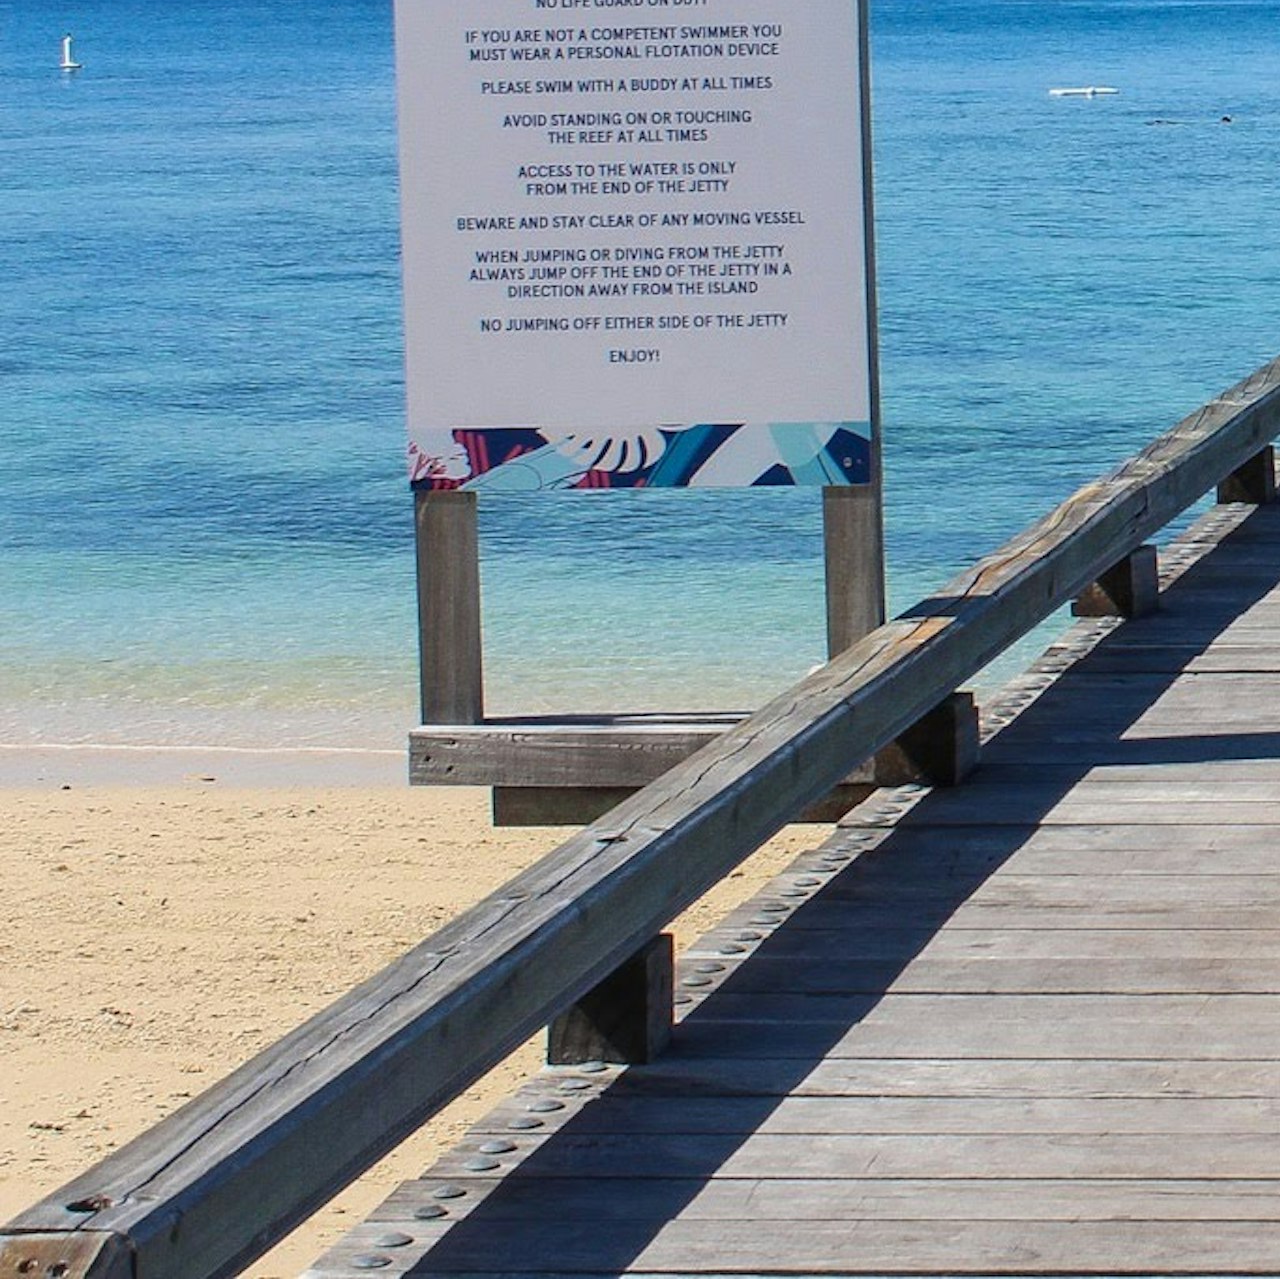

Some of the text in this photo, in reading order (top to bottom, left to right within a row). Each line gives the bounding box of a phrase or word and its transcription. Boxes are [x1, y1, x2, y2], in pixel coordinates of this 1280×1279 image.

[464, 24, 782, 44] IF YOU ARE NOT A COMPETENT SWIMMER YOU
[469, 42, 780, 62] MUST WEAR A PERSONAL FLOTATION DEVICE
[480, 75, 773, 95] PLEASE SWIM WITH A BUDDY AT ALL TIMES
[502, 109, 753, 128] AVOID STANDING ON OR TOUCHING
[547, 128, 708, 145] THE REEF AT ALL TIMES
[517, 160, 737, 179] ACCESS TO THE WATER IS ONLY
[525, 178, 729, 196] FROM THE END OF THE JETTY
[456, 211, 806, 232] BEWARE AND STAY CLEAR OF ANY MOVING VESSEL
[474, 244, 785, 264] WHEN JUMPING OR DIVING FROM THE JETTY
[468, 262, 793, 282] ALWAYS JUMP OFF THE END OF THE JETTY IN A
[507, 280, 759, 299] DIRECTION AWAY FROM THE ISLAND
[479, 313, 788, 333] NO JUMPING OFF EITHER SIDE OF THE JETTY
[608, 349, 660, 363] ENJOY!
